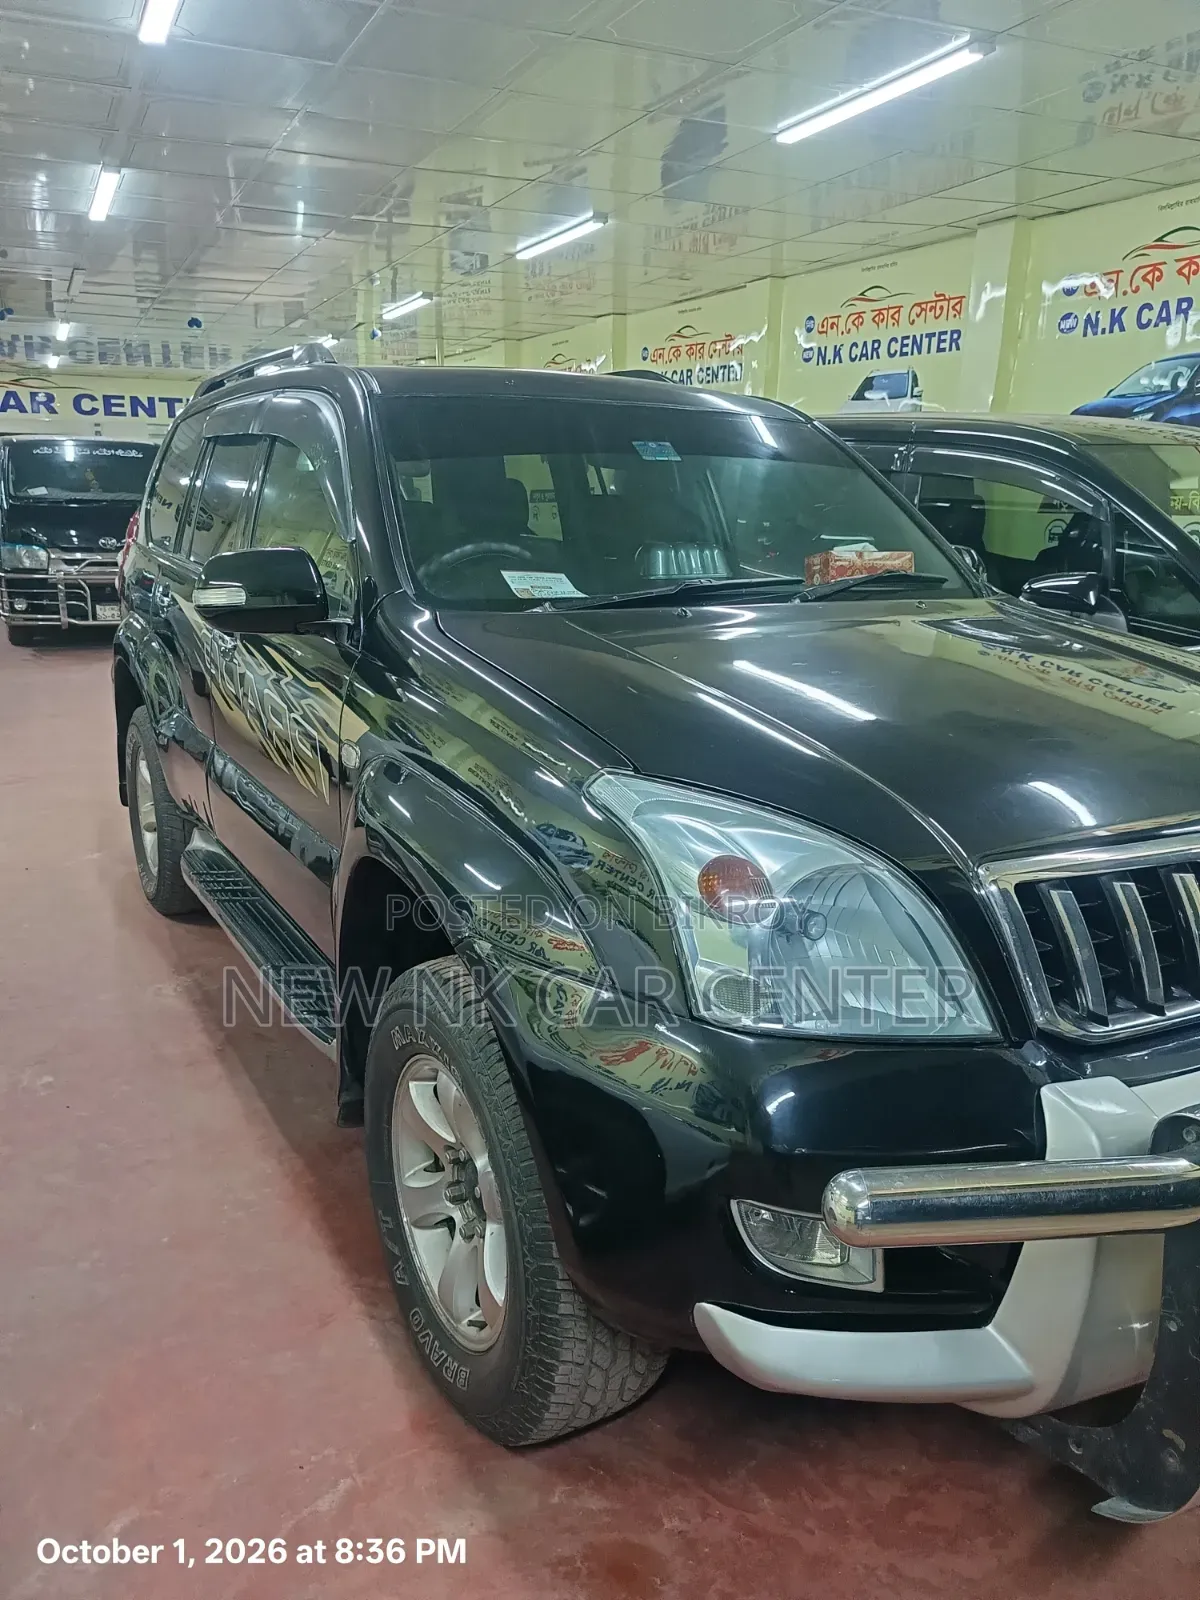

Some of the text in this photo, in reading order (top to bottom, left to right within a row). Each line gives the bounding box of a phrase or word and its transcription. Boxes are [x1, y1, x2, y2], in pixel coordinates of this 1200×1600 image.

[817, 291, 966, 338] এন.কে কার সেন্টার
[1082, 296, 1194, 337] N.K CAR
[685, 341, 706, 361] কার
[816, 329, 962, 366] N.K CAR CENTER
[72, 393, 193, 418] CENT
[409, 1306, 470, 1391] BRAVO
